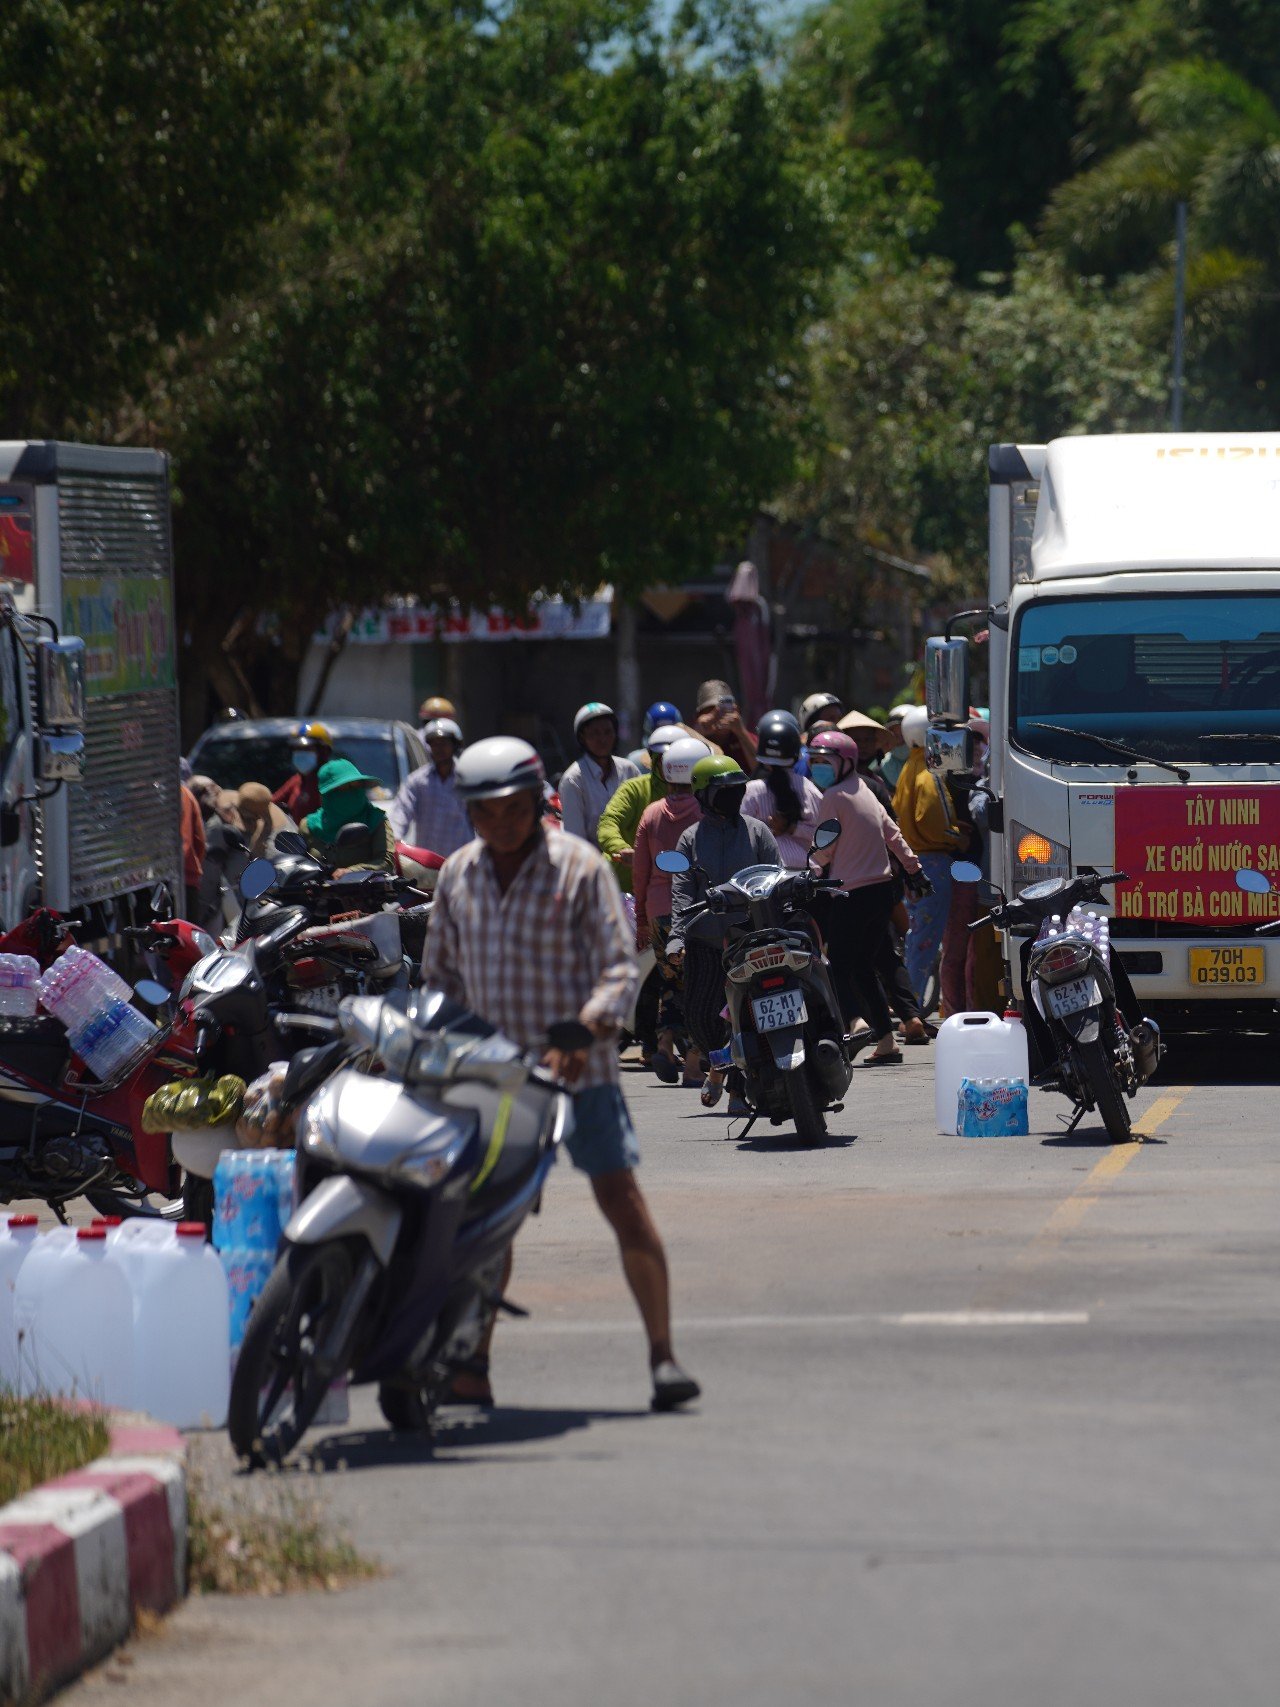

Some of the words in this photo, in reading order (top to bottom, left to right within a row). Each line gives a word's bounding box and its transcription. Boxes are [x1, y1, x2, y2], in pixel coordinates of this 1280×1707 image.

[1185, 794, 1218, 826] TÂY
[1220, 798, 1260, 825] NINH
[1145, 845, 1166, 872] XE
[1170, 836, 1204, 872] CHỞ
[1208, 840, 1252, 872] NƯỚC
[1147, 888, 1179, 921] TRỢ
[1182, 885, 1205, 917] BÀ
[1209, 890, 1243, 917] CON
[1211, 949, 1243, 964] 70H
[1198, 967, 1257, 982] 039.03
[1054, 979, 1089, 1001] 62-M1
[759, 993, 796, 1015] 62-M1
[758, 1006, 804, 1030] 792.81
